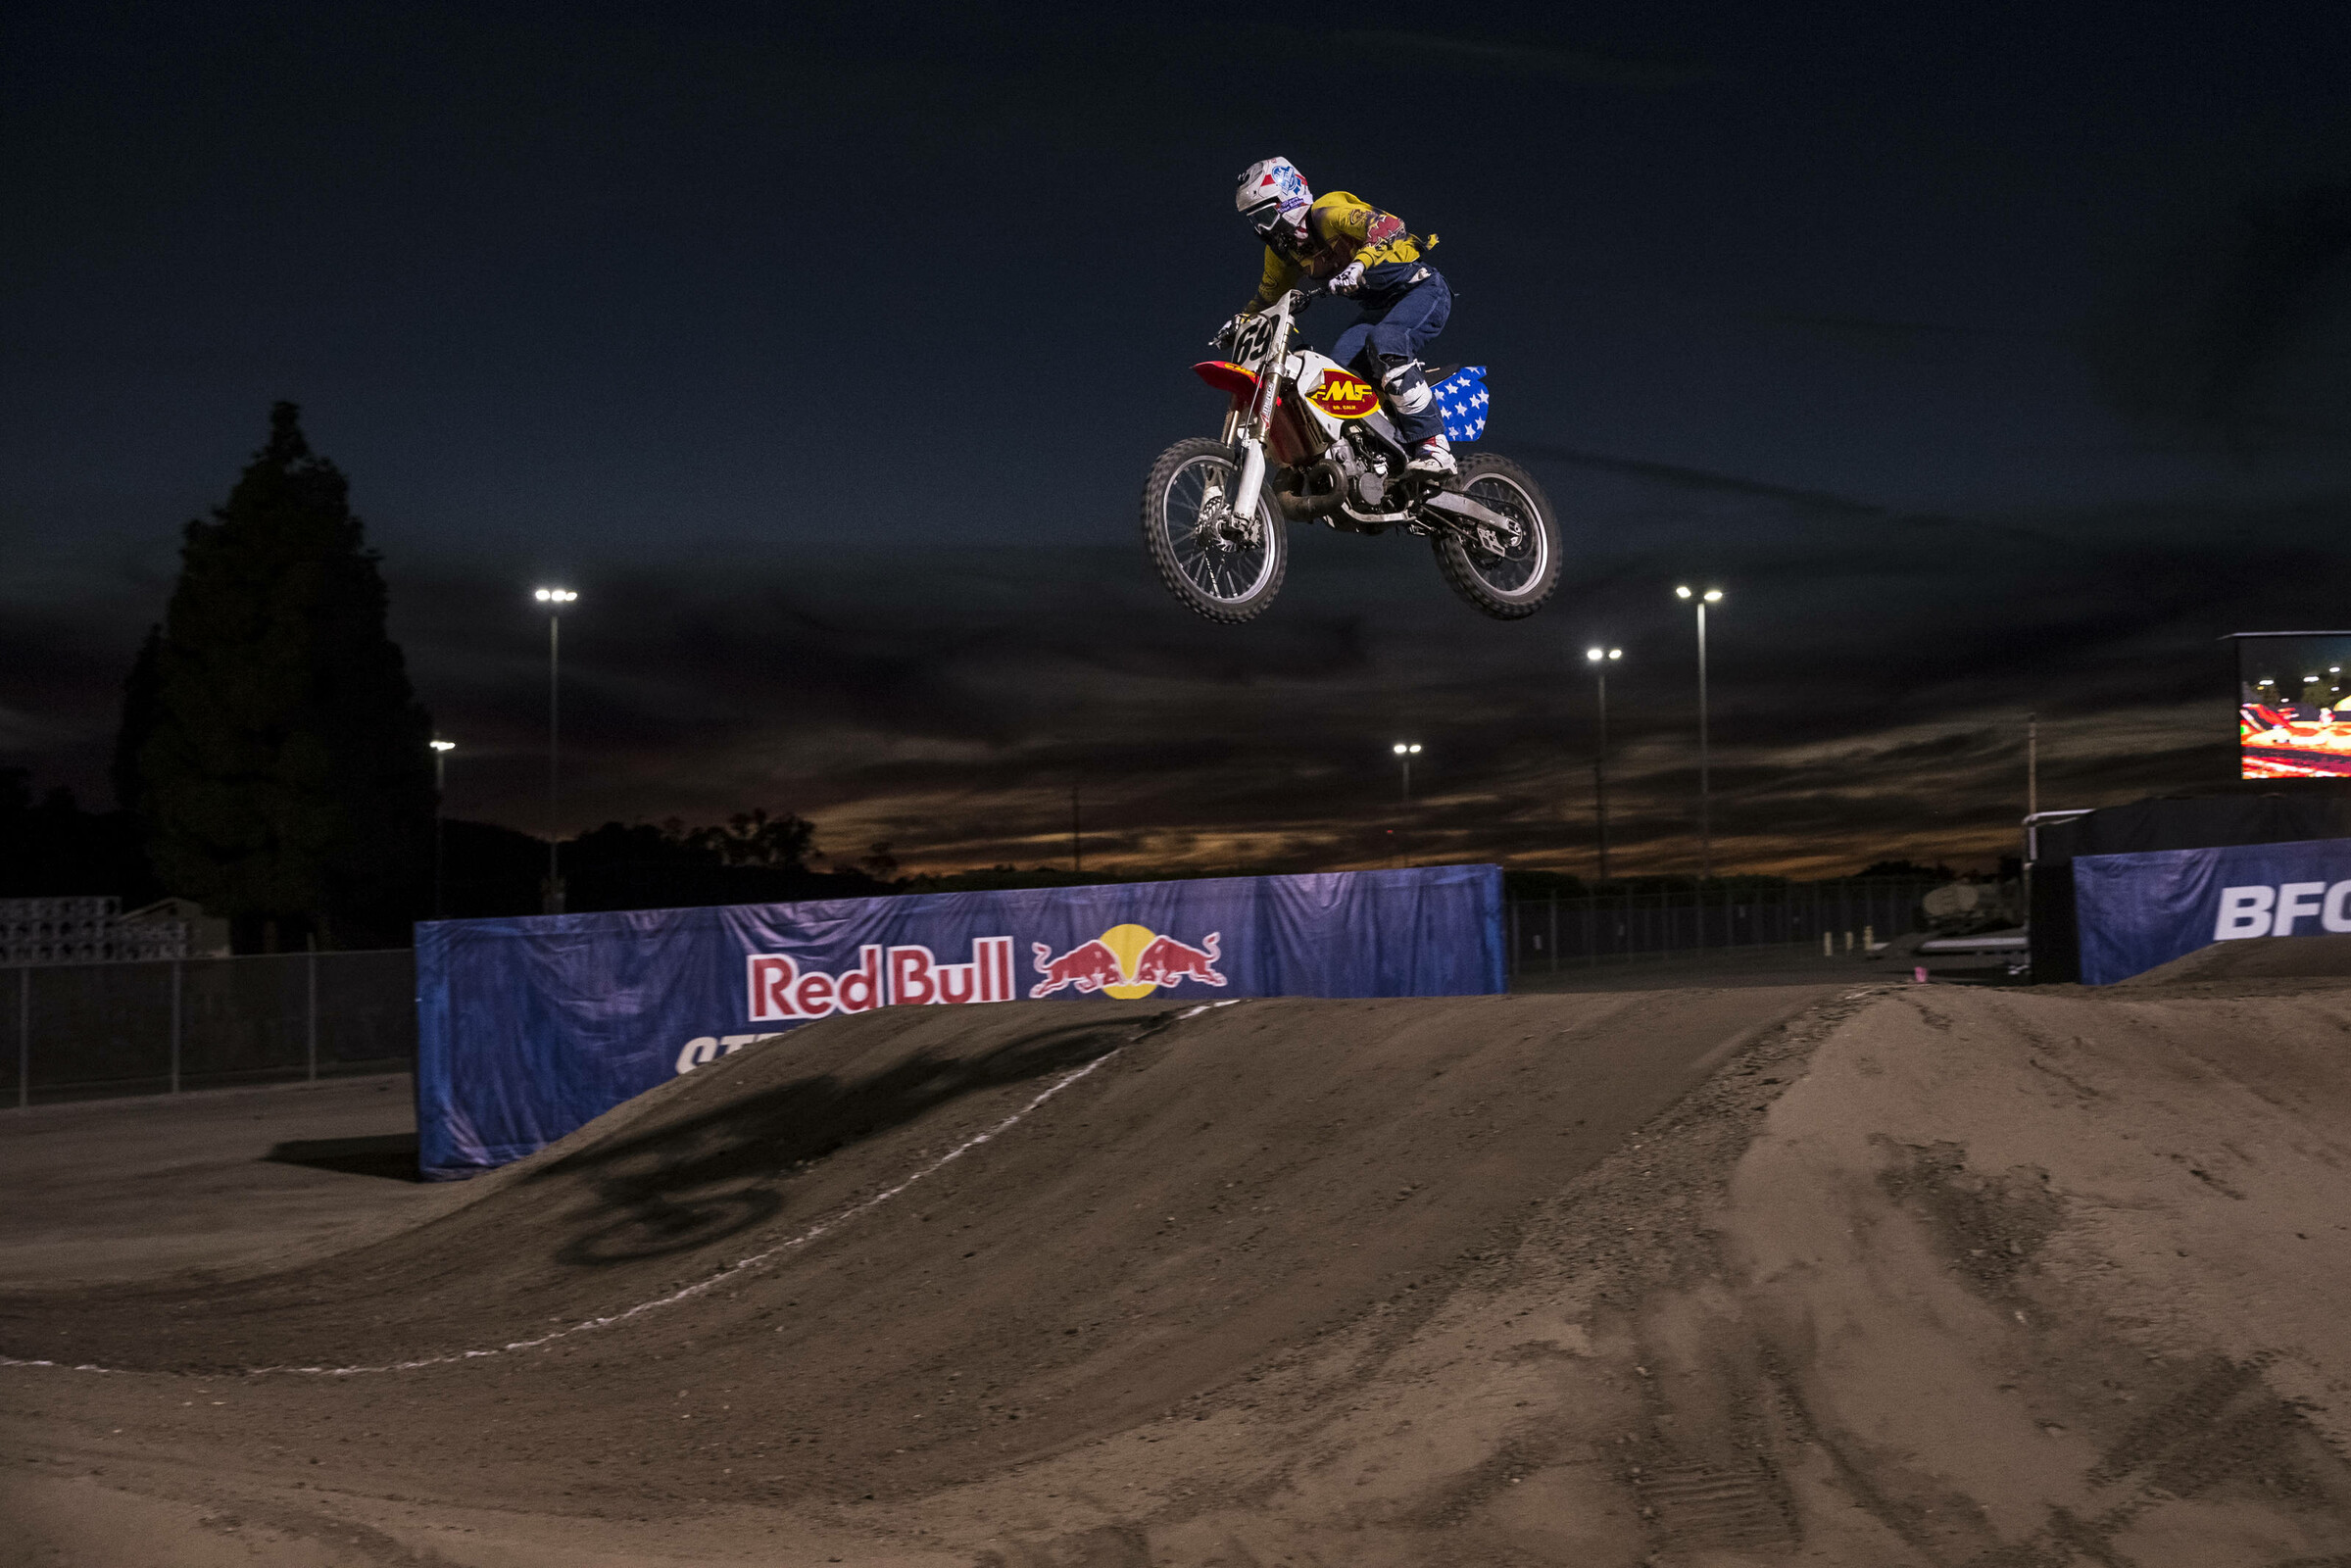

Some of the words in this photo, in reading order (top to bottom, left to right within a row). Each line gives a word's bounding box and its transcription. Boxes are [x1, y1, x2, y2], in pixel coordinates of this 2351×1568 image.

[1233, 314, 1280, 366] 69
[1311, 380, 1373, 402] FMF
[750, 946, 881, 1019] Red
[890, 938, 1012, 1005] Bull
